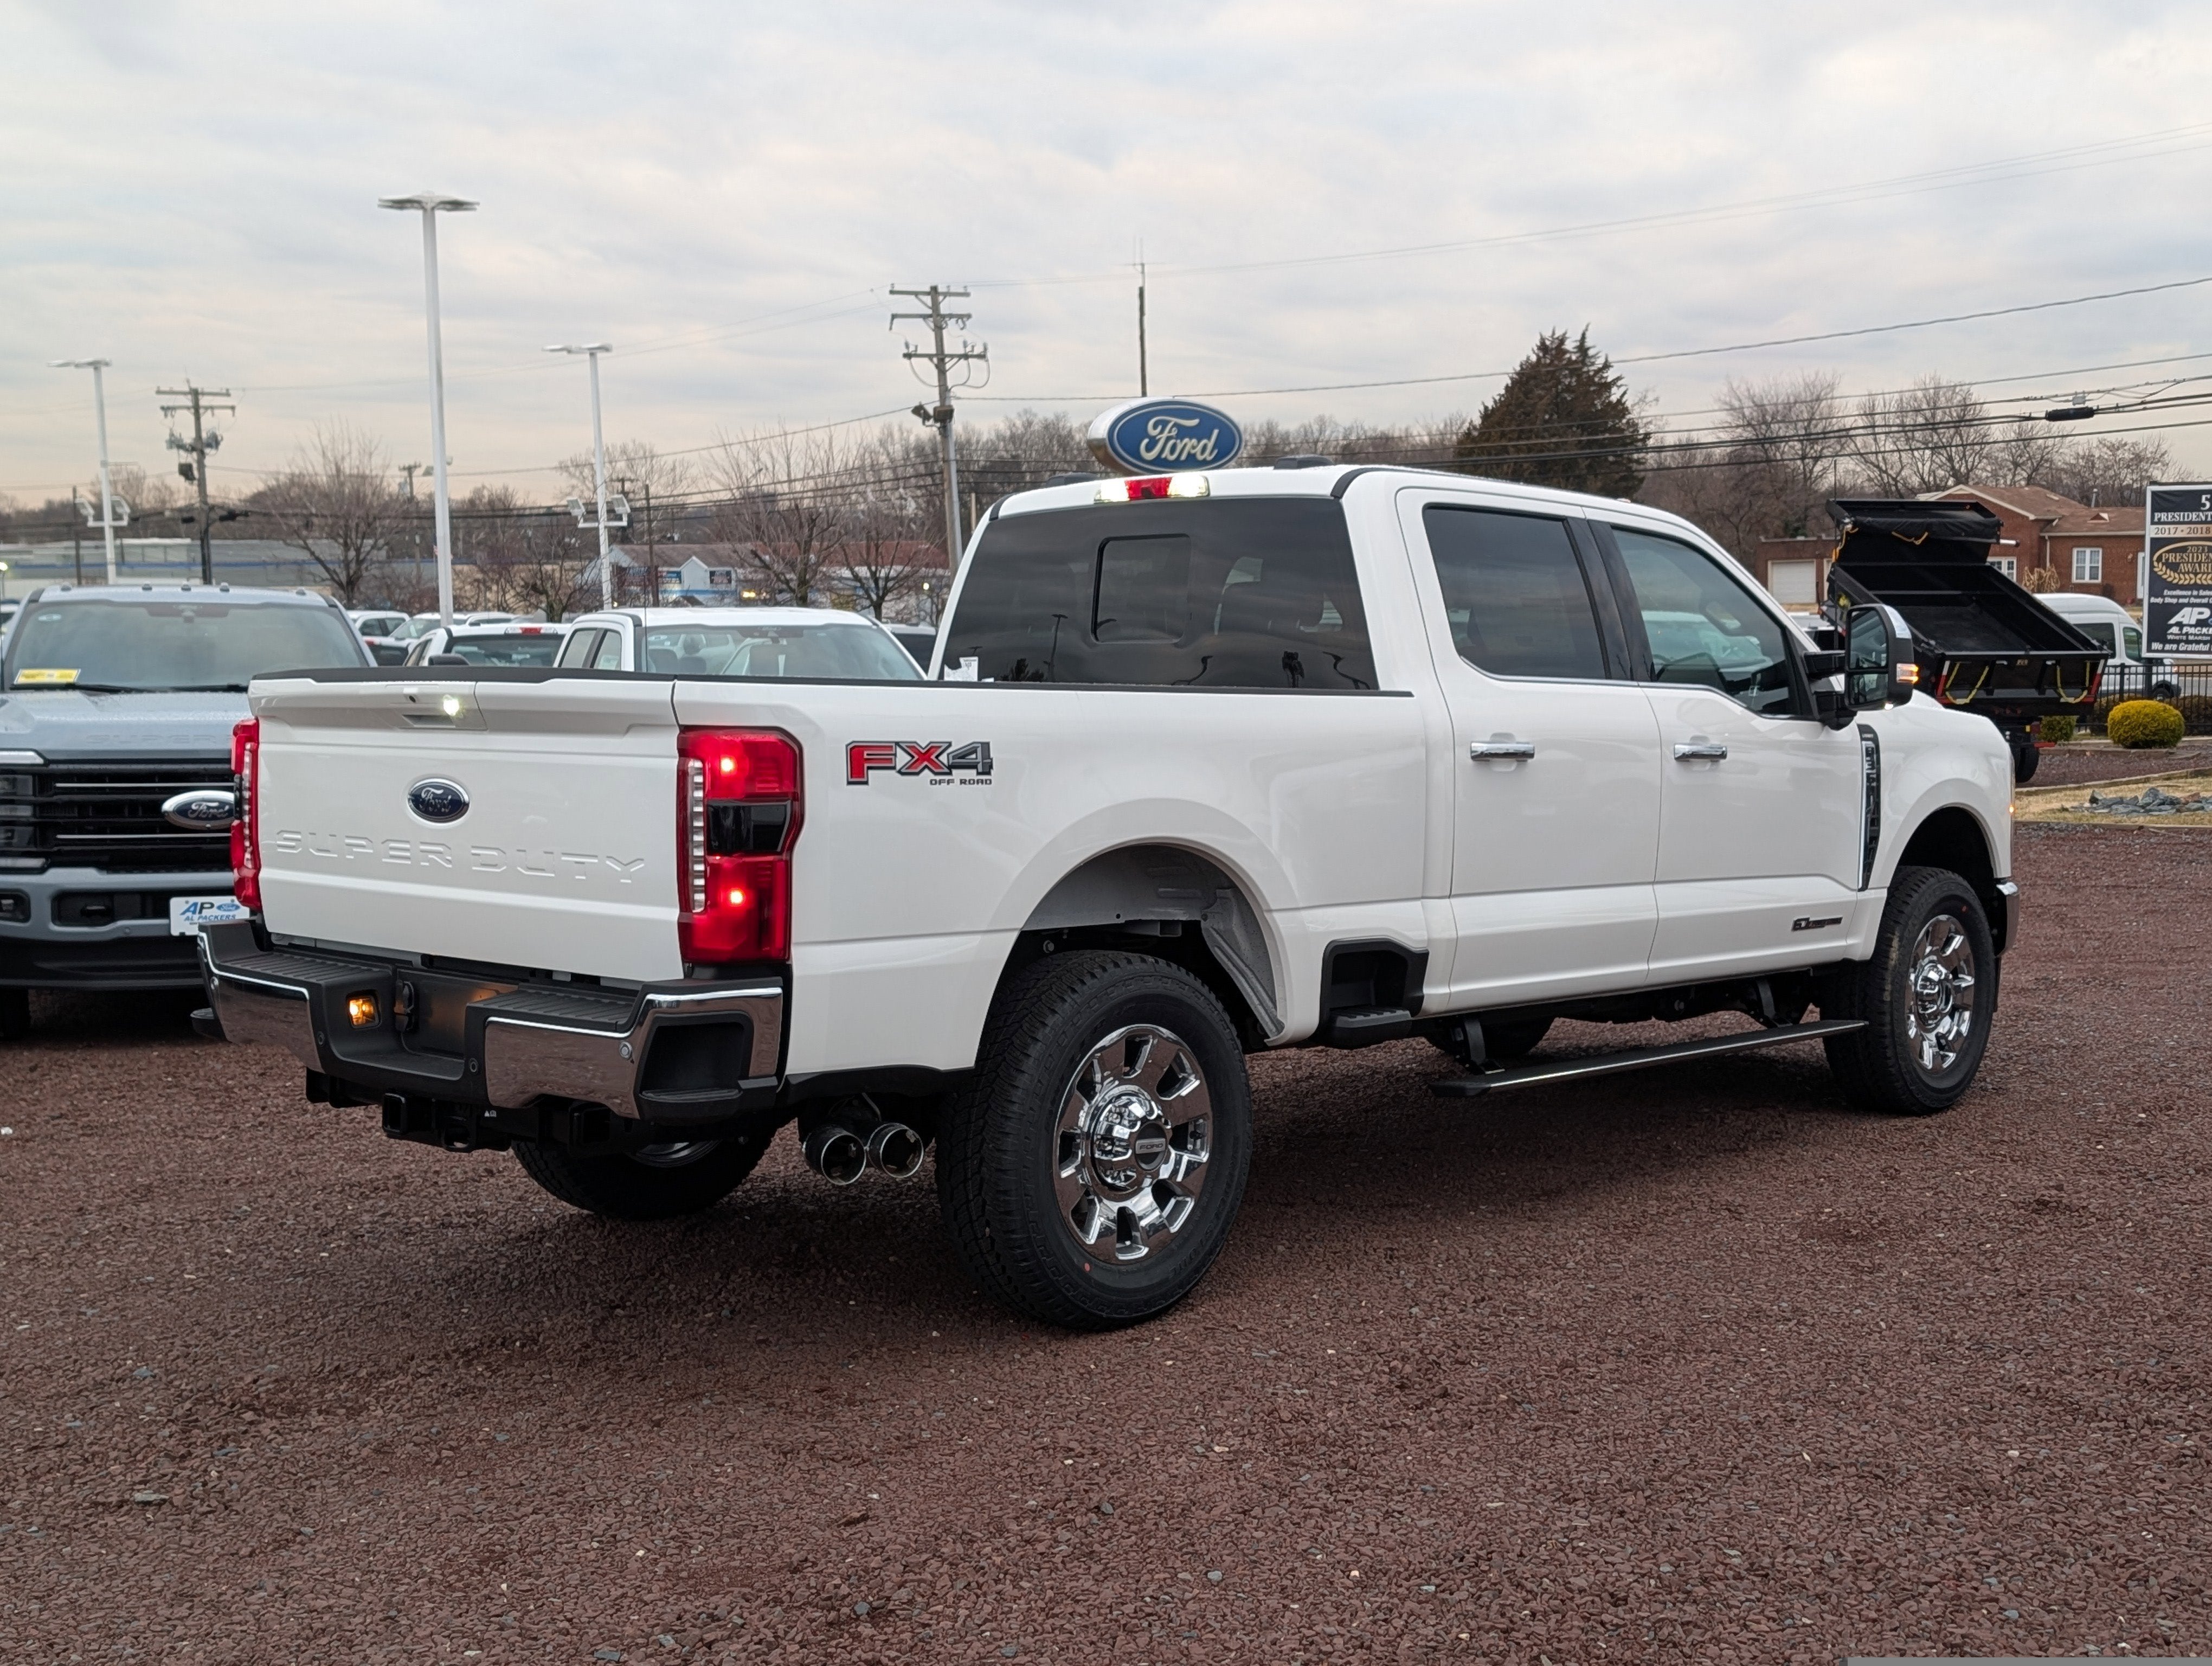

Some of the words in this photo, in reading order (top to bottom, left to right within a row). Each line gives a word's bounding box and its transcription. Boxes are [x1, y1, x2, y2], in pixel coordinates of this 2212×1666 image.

[1140, 416, 1219, 460] Ford
[2201, 494, 2211, 510] 5
[2155, 527, 2178, 535] 2017
[2187, 527, 2211, 535] 2018
[2168, 607, 2211, 624] AP
[2151, 642, 2163, 650] We
[2178, 643, 2210, 651] Grateful
[845, 740, 993, 786] FX4
[188, 802, 229, 818] Ford
[276, 830, 452, 868] SUPER
[471, 845, 645, 883] DUTY
[180, 902, 215, 915] AP
